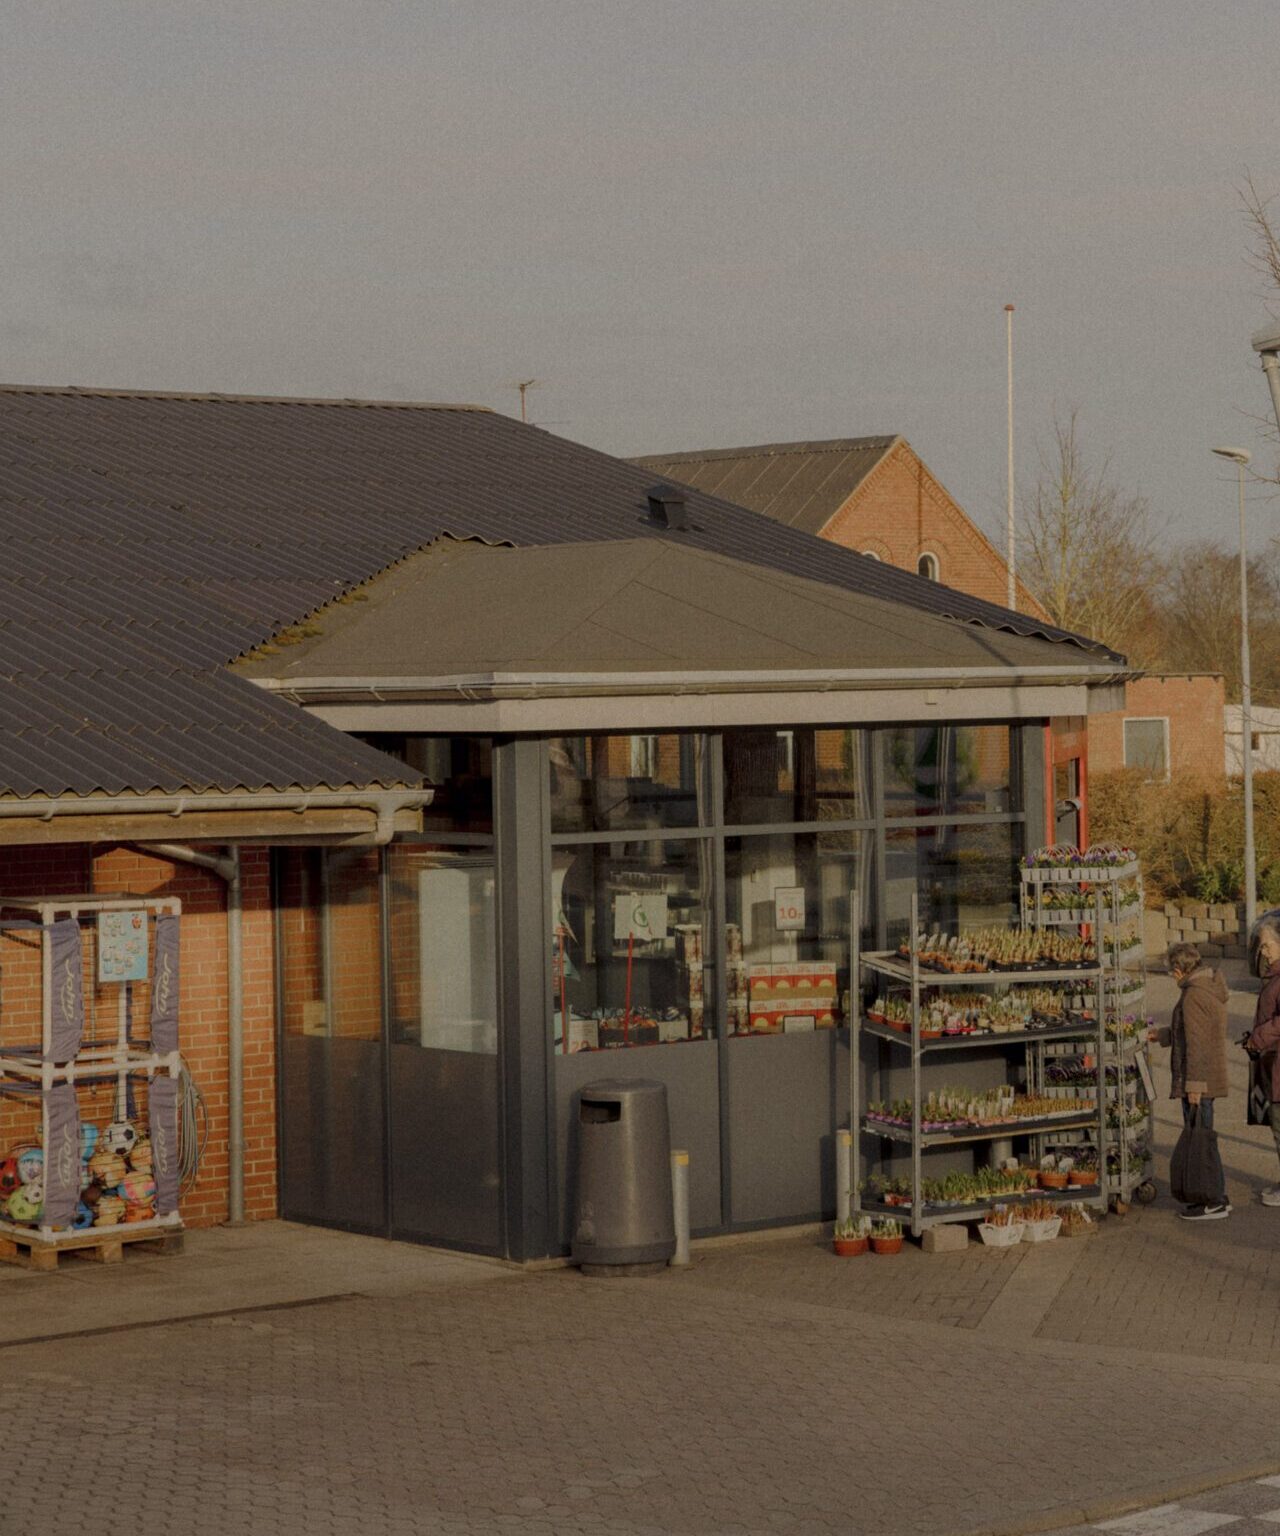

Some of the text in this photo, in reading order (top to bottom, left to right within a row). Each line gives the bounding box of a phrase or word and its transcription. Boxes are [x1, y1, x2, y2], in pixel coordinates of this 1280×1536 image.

[60, 958, 77, 1025] John
[155, 952, 172, 1017] John
[58, 1122, 75, 1190] John
[155, 1113, 169, 1178] John
